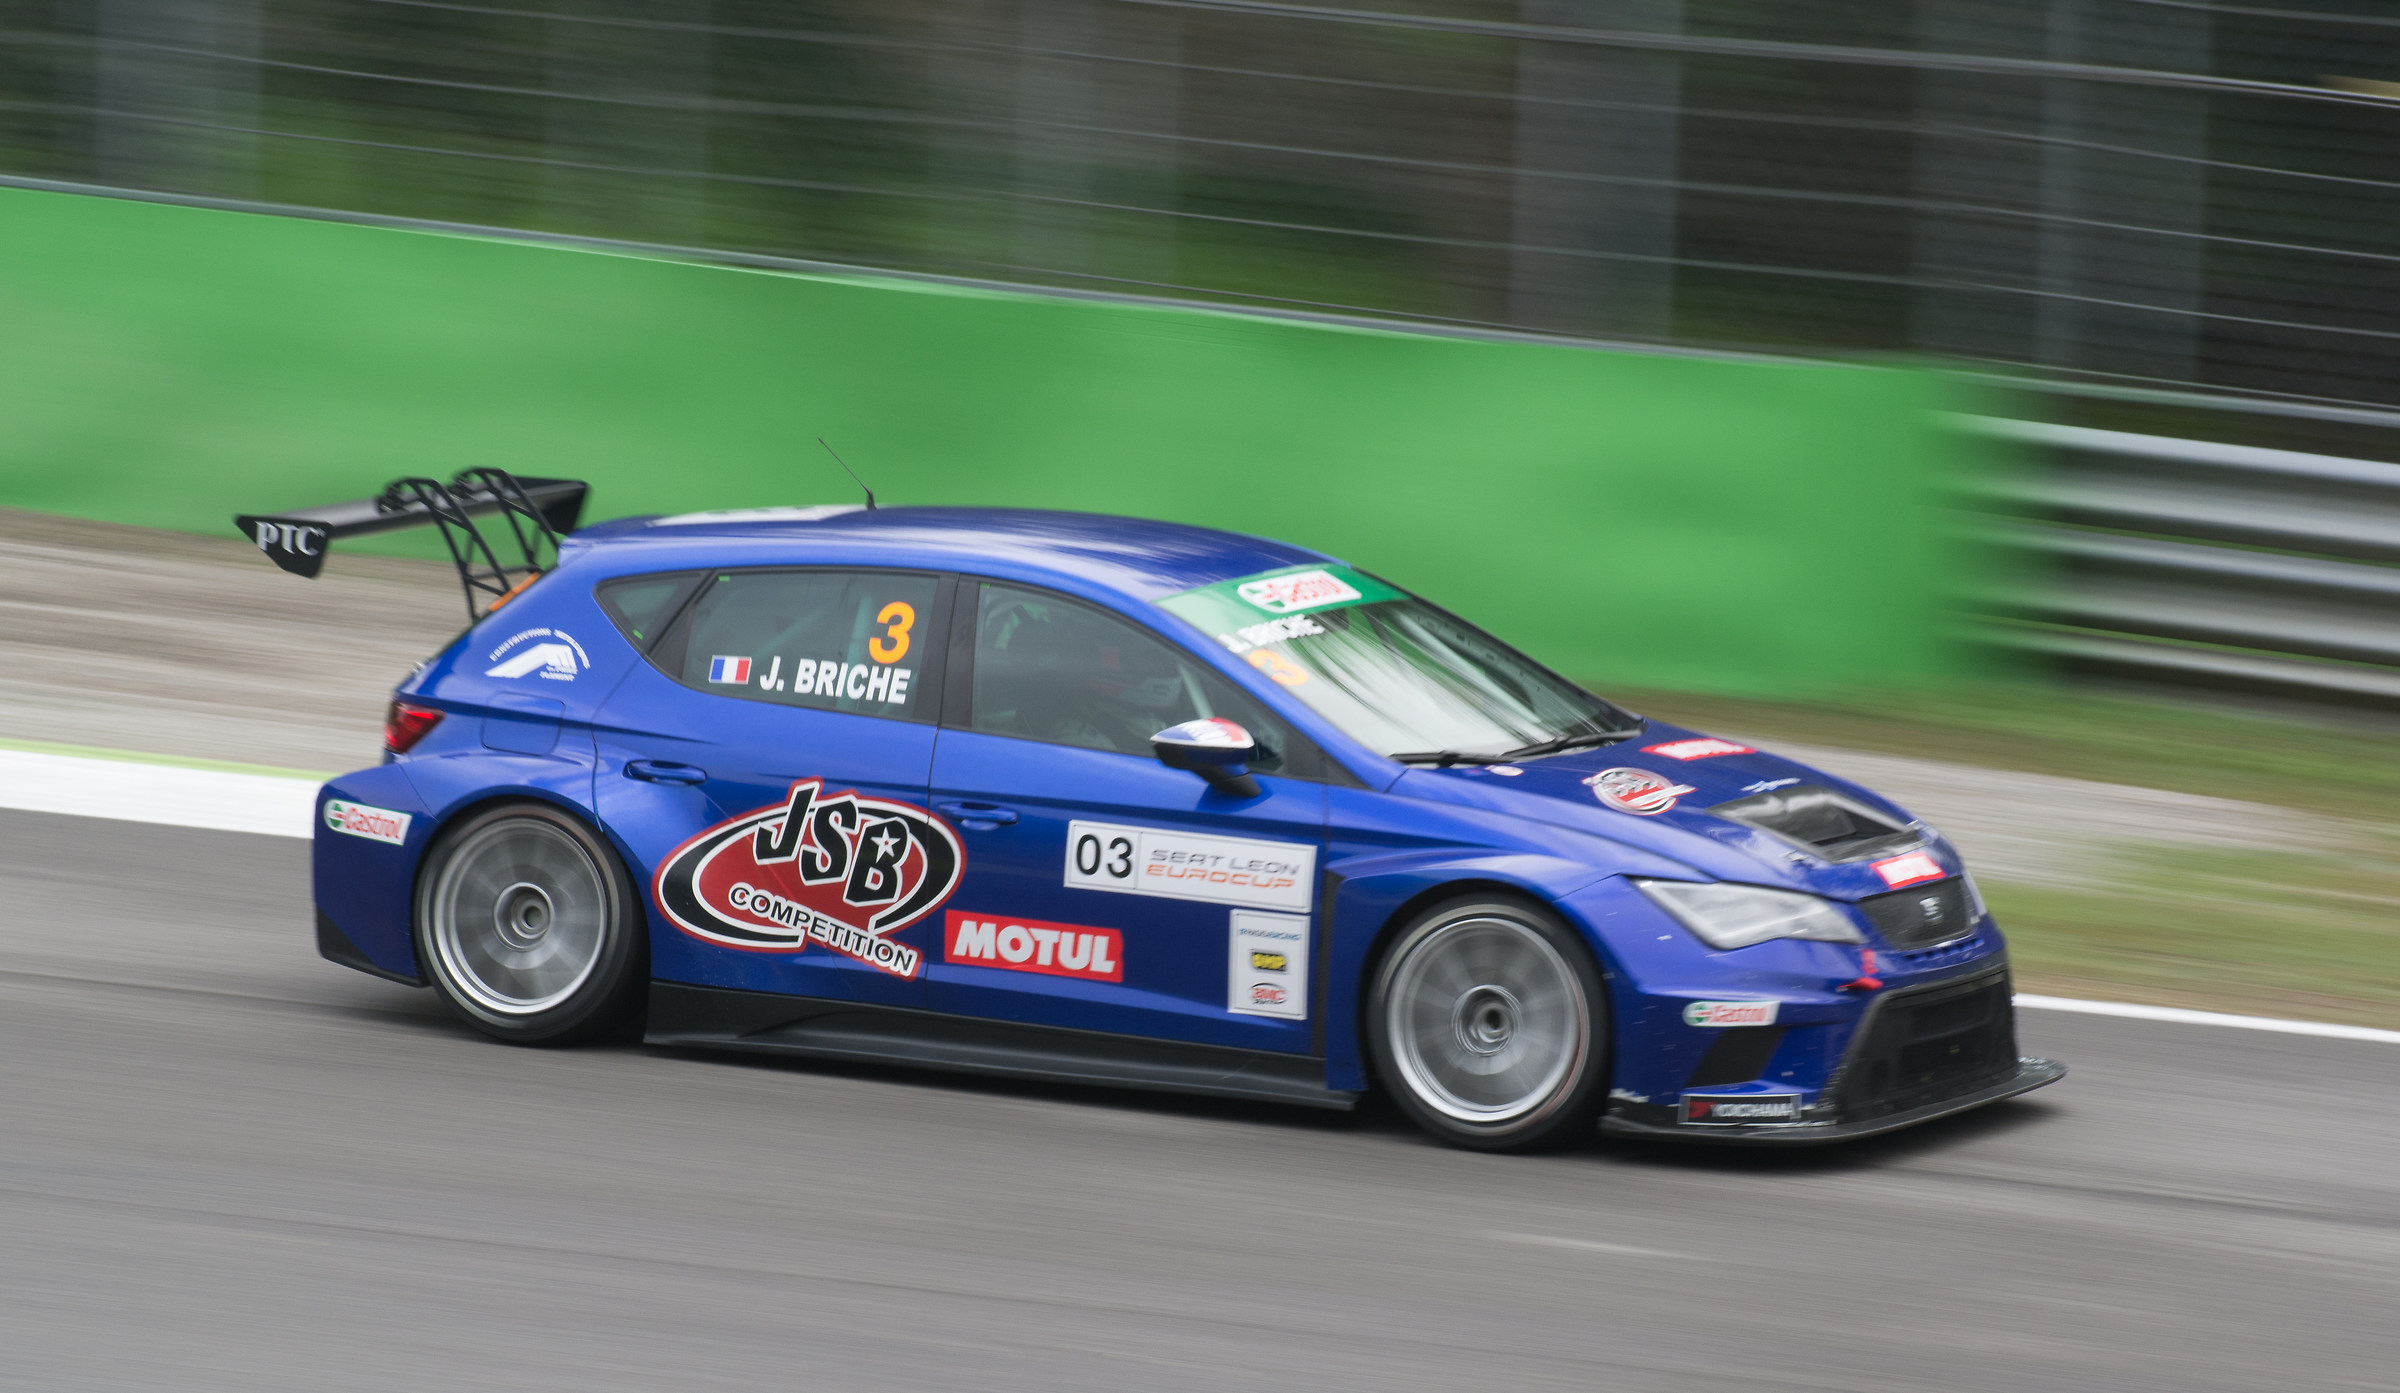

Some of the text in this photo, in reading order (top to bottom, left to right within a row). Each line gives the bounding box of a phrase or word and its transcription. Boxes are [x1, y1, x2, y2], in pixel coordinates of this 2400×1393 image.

[254, 520, 320, 556] PTC
[868, 601, 915, 664] 3
[759, 656, 911, 705] J. BRICHE
[1248, 649, 1309, 686] 3
[343, 807, 403, 840] Castrol
[753, 781, 910, 907] JSB
[1076, 834, 1133, 878] 03
[1146, 864, 1296, 889] EUROCUP
[1150, 849, 1301, 877] SEAT LEON
[730, 886, 913, 972] COMPETITION
[952, 920, 1116, 973] MOTUL
